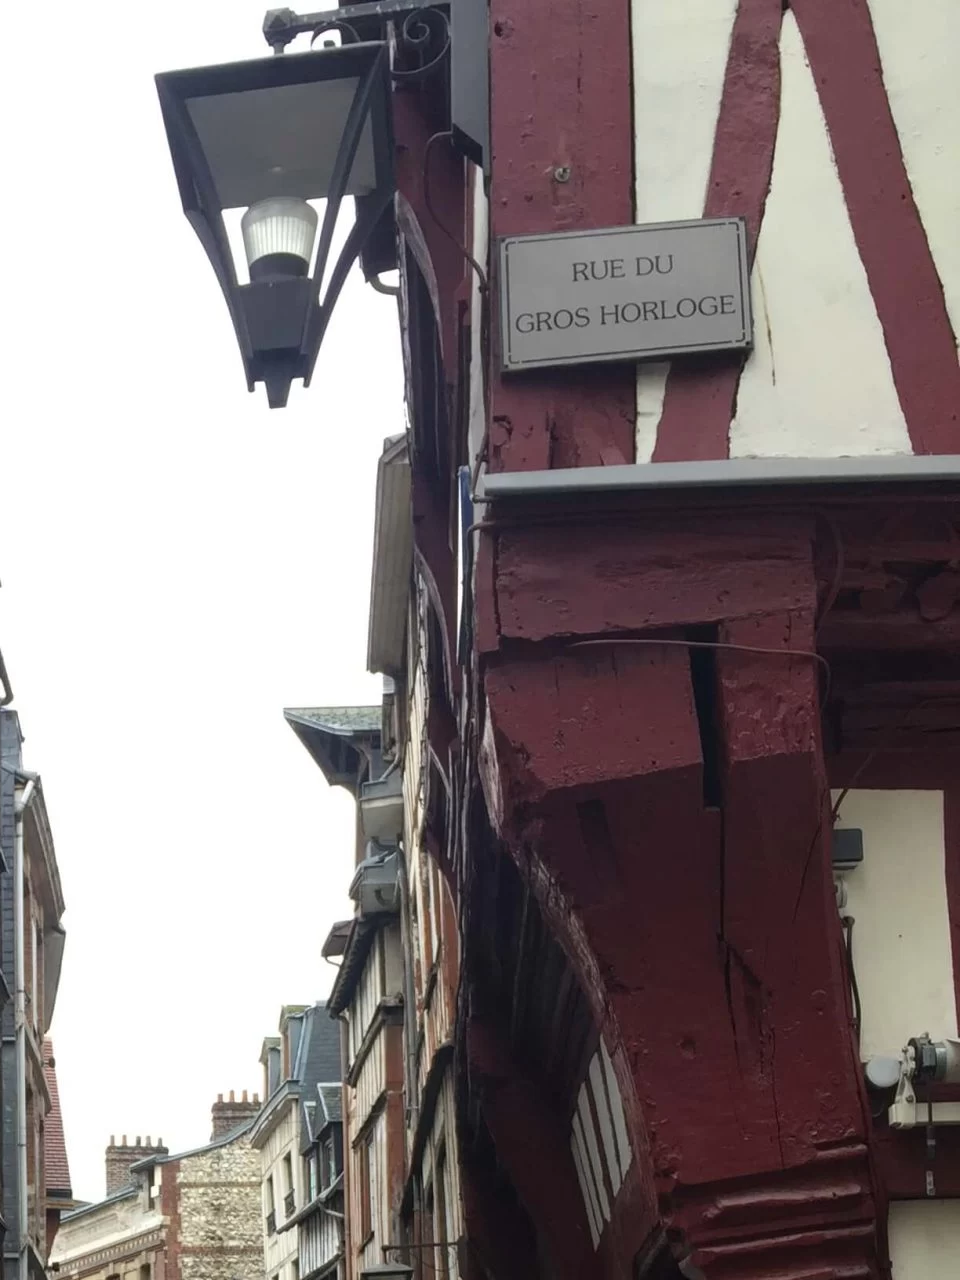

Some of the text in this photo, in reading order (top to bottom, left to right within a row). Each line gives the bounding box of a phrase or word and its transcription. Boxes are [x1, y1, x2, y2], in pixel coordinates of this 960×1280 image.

[571, 254, 674, 282] RUE DU
[515, 294, 737, 334] GROS HORLOGE
